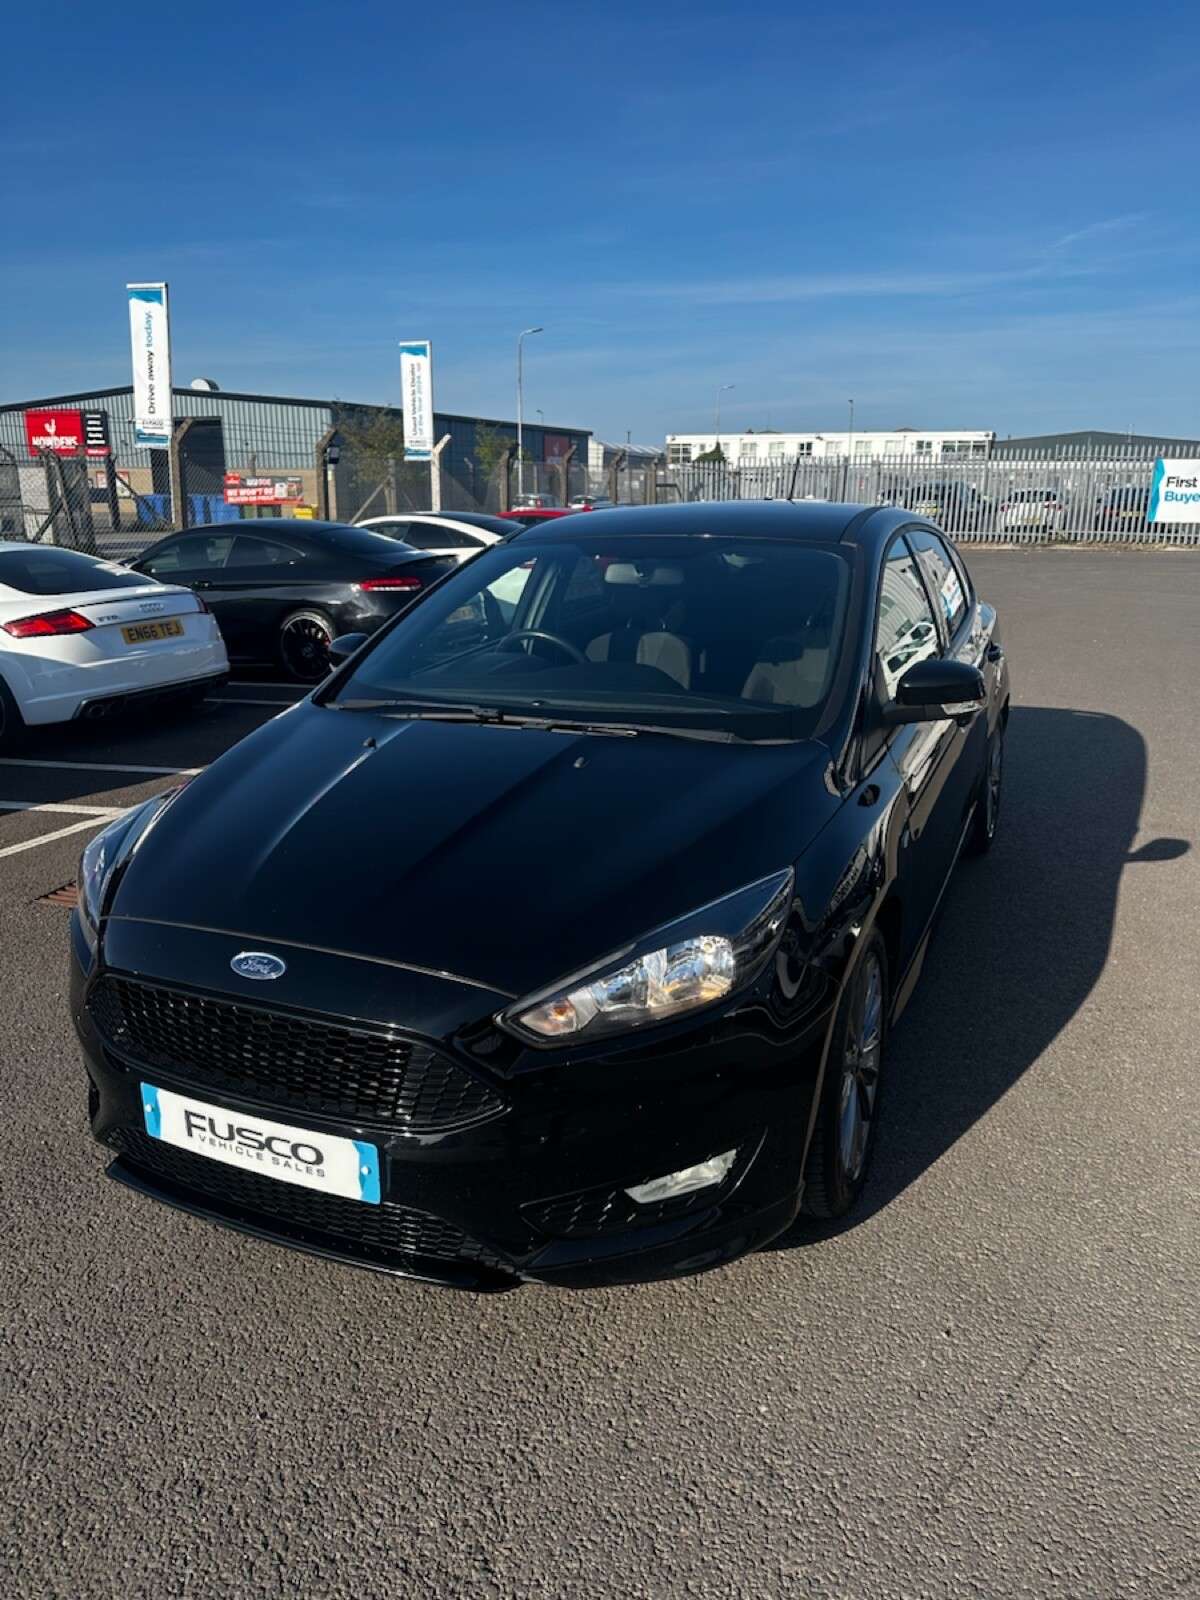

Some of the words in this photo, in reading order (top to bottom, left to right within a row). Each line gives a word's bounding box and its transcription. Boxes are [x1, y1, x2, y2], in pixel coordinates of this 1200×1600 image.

[147, 350, 155, 381] away
[148, 383, 156, 414] Drive
[1166, 475, 1198, 488] First
[127, 624, 157, 641] EN66
[159, 620, 181, 637] TEJ
[240, 956, 274, 974] Ford
[184, 1109, 324, 1166] FUSCO
[199, 1133, 264, 1161] VEHICLE
[271, 1155, 325, 1178] SALES
